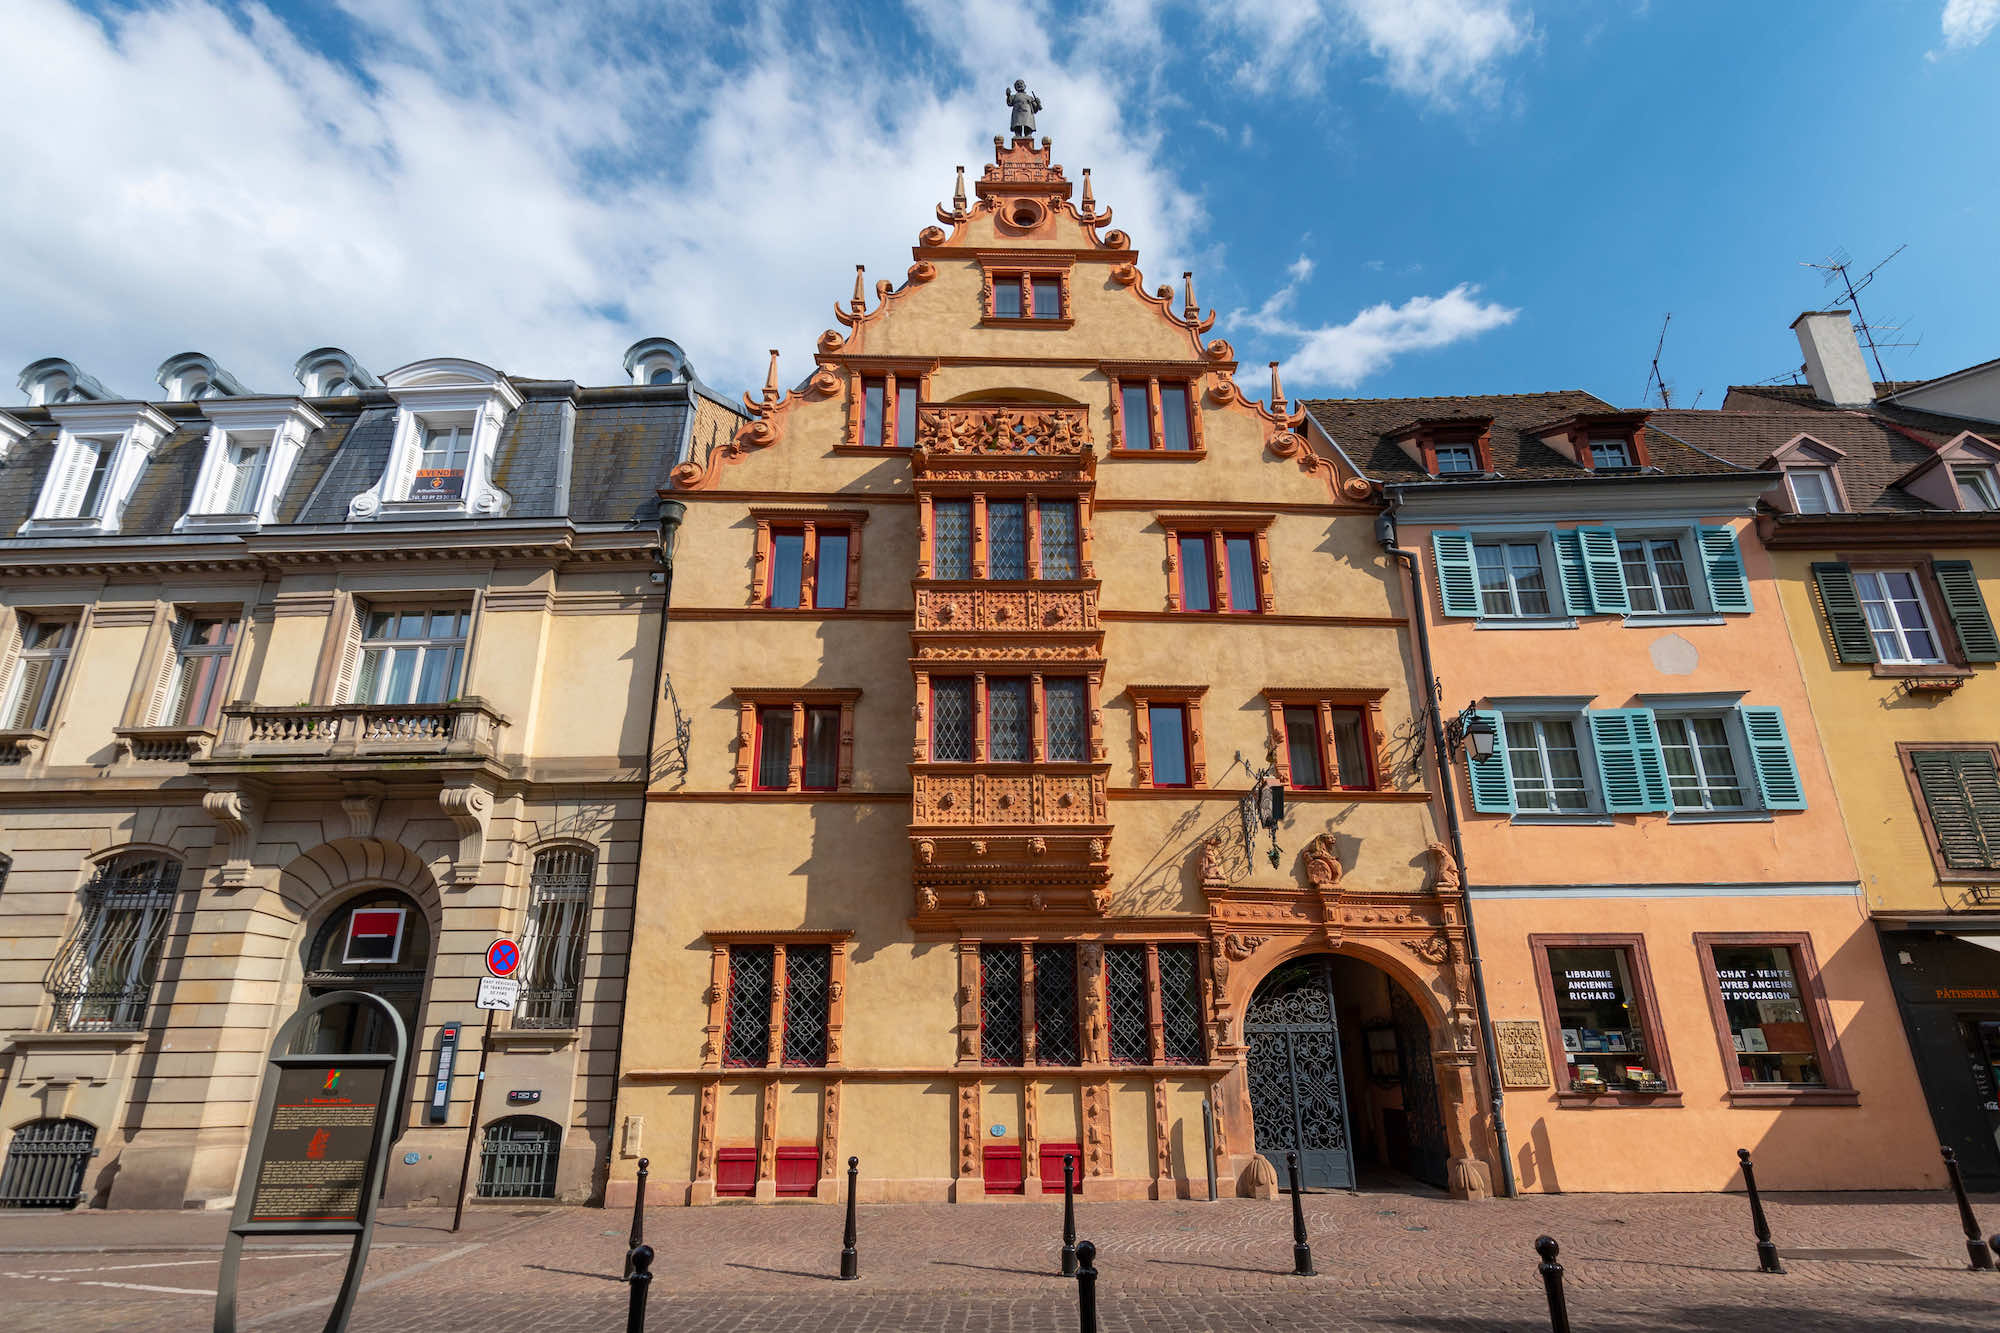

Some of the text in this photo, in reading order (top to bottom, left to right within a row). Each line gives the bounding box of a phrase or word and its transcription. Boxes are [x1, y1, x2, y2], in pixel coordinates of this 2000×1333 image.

[1565, 970, 1611, 978] LIBRAIRIE
[1756, 970, 1791, 978] VENTE
[1568, 981, 1614, 989] ANCIENNE
[1720, 981, 1793, 989] IVRES ANCIENS
[1569, 992, 1616, 1000] RICHARD
[1733, 992, 1790, 1000] D'OCCASION
